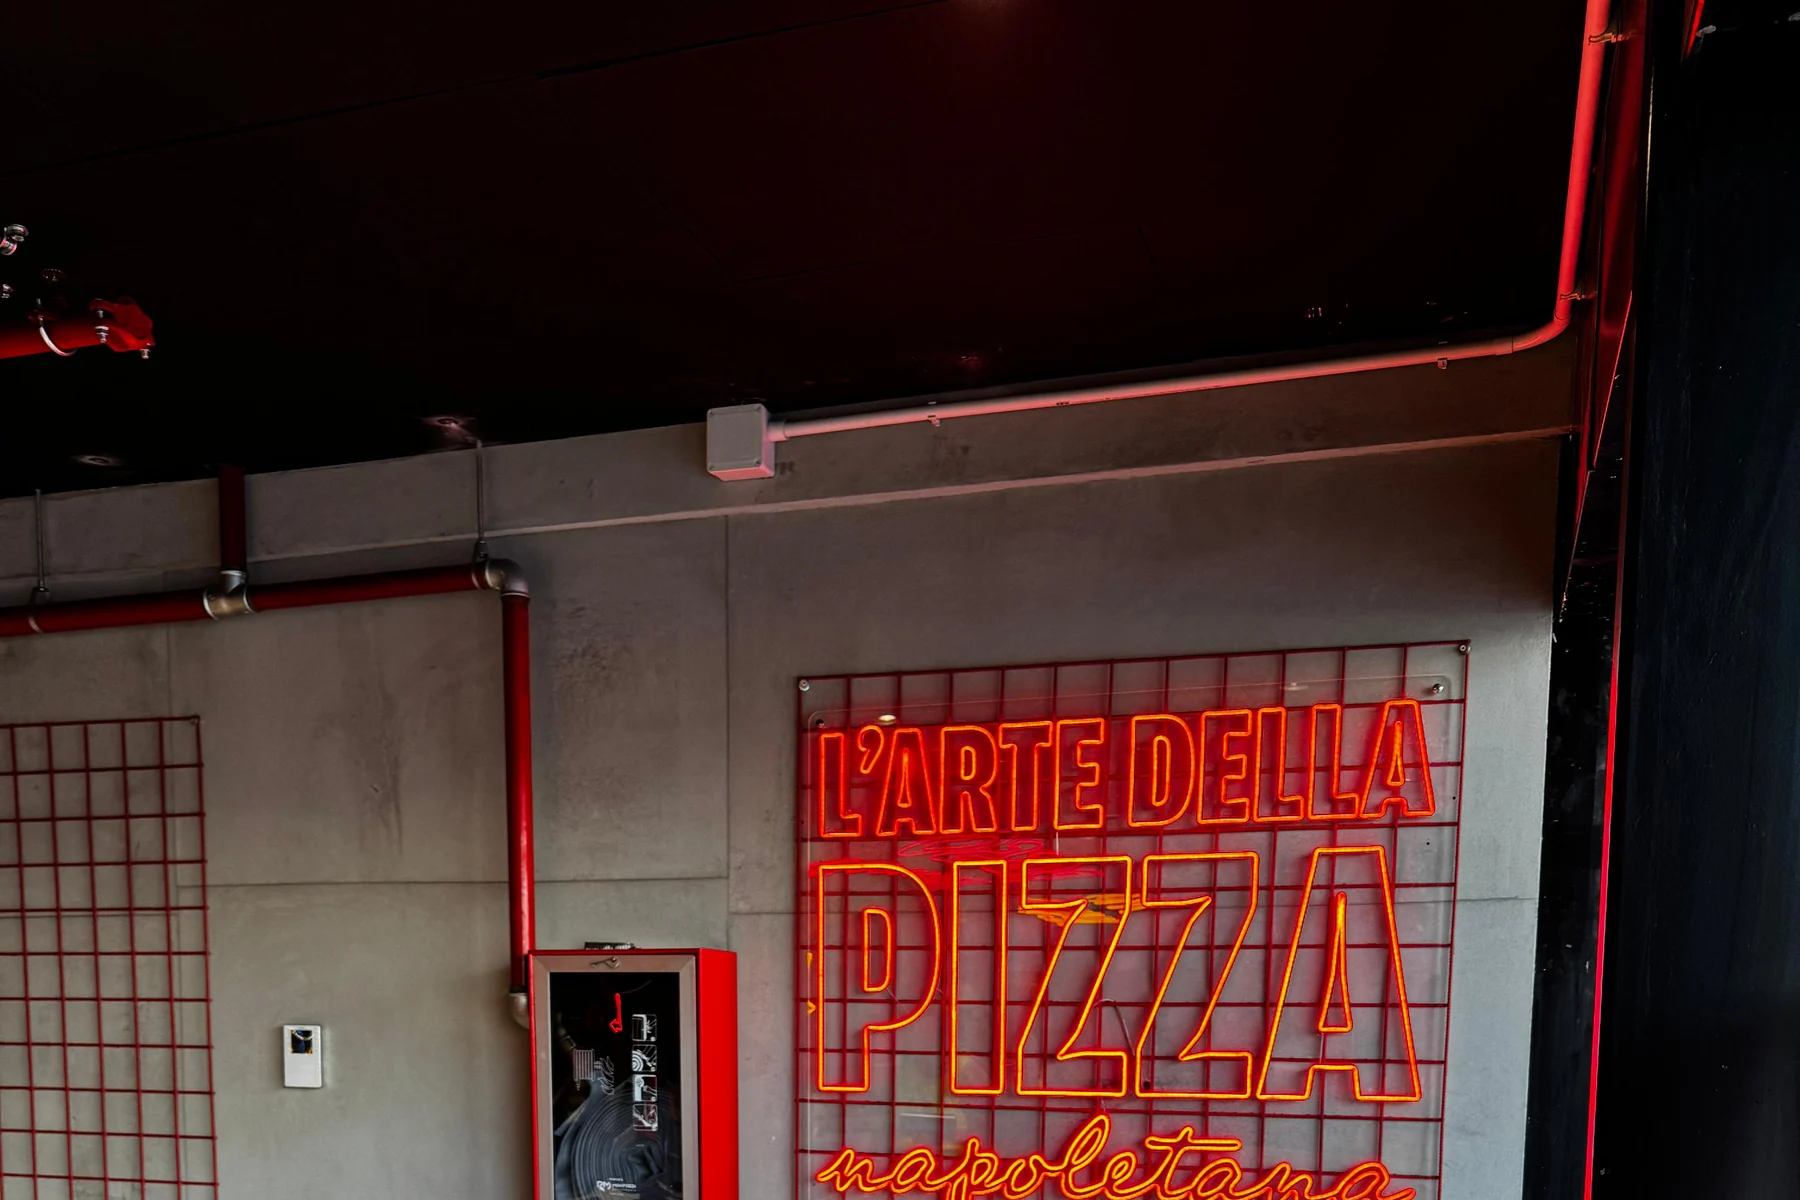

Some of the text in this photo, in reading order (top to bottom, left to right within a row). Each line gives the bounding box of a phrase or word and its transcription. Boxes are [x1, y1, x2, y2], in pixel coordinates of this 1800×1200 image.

[818, 698, 1436, 837] L'ARTE DELLA
[816, 846, 1422, 1102] PIZZA
